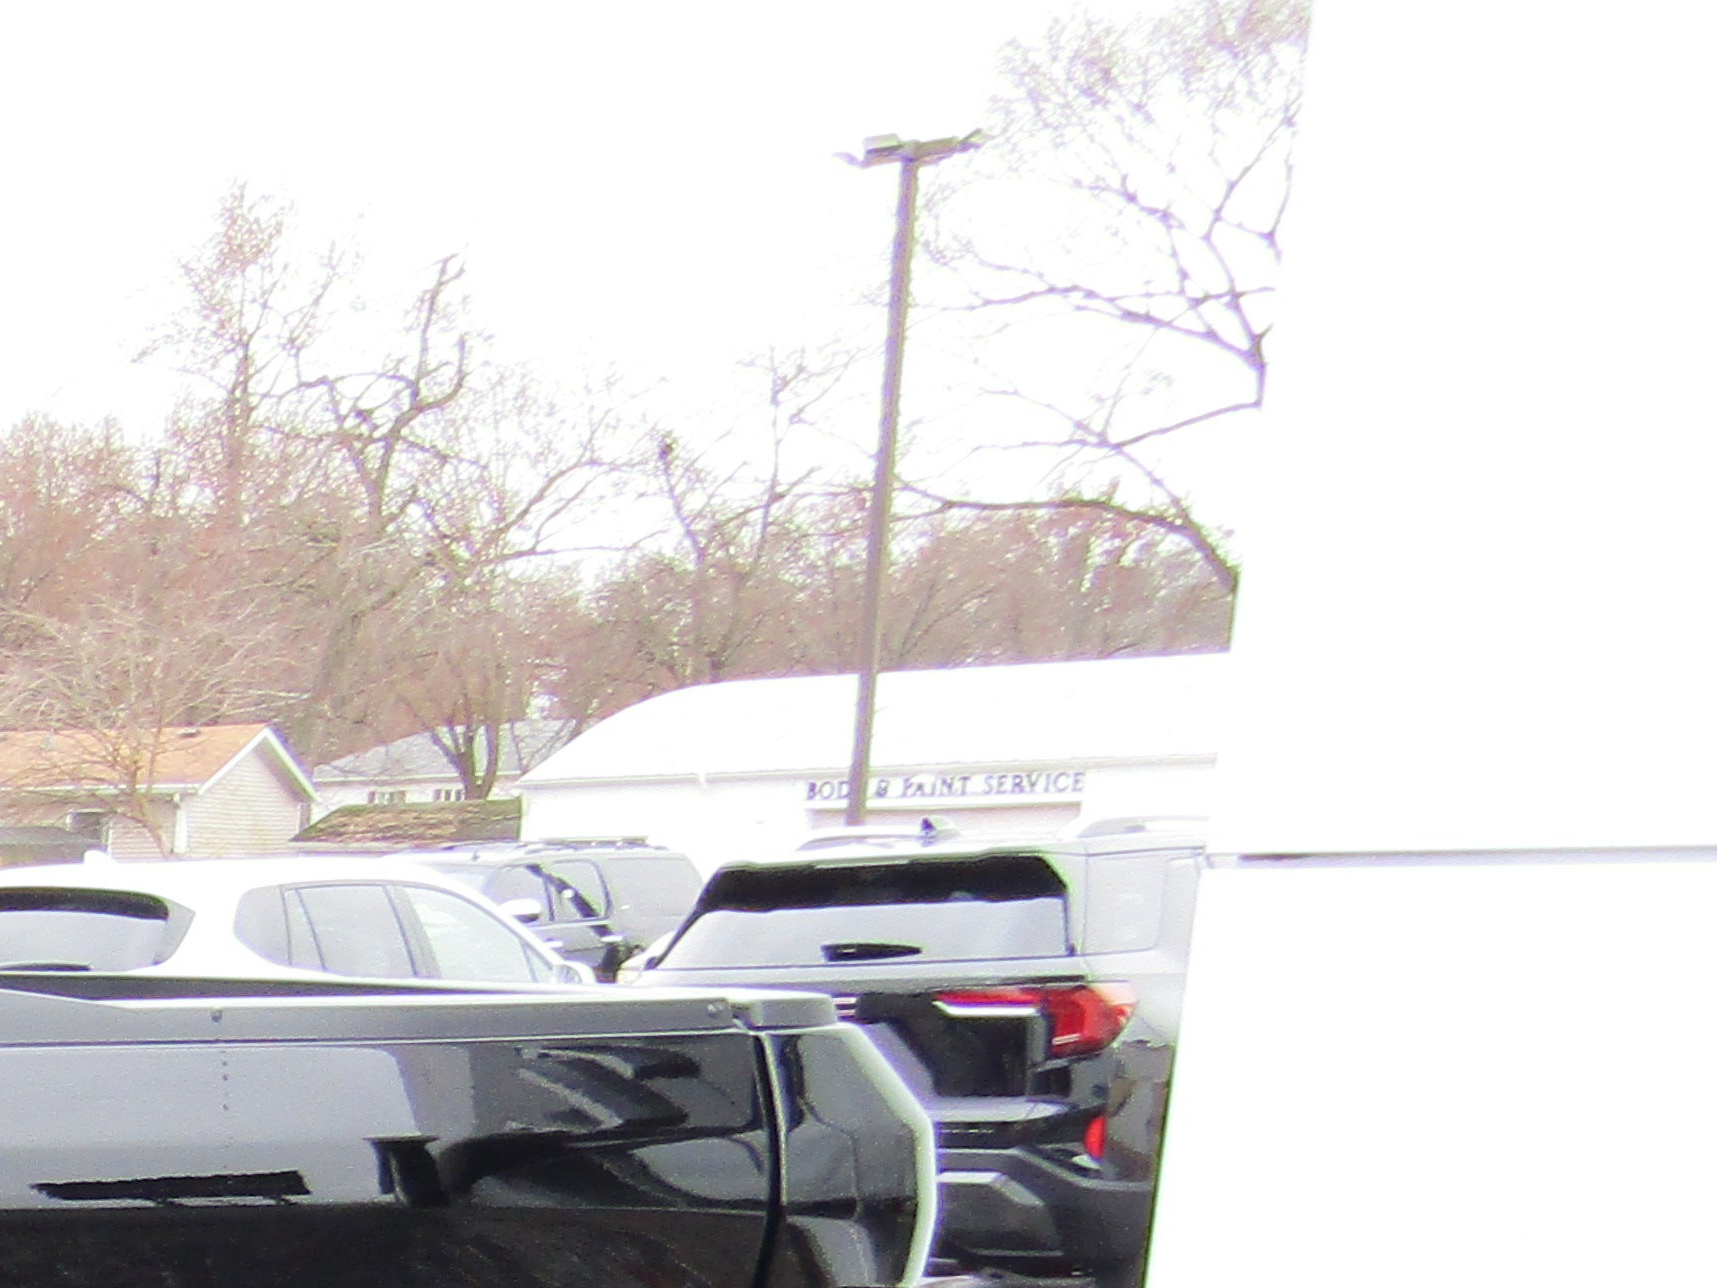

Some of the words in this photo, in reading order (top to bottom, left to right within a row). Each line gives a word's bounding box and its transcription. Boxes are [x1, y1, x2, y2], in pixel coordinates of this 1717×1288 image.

[806, 781, 859, 800] BOD
[875, 779, 890, 798] &
[982, 772, 1085, 794] SERVICE
